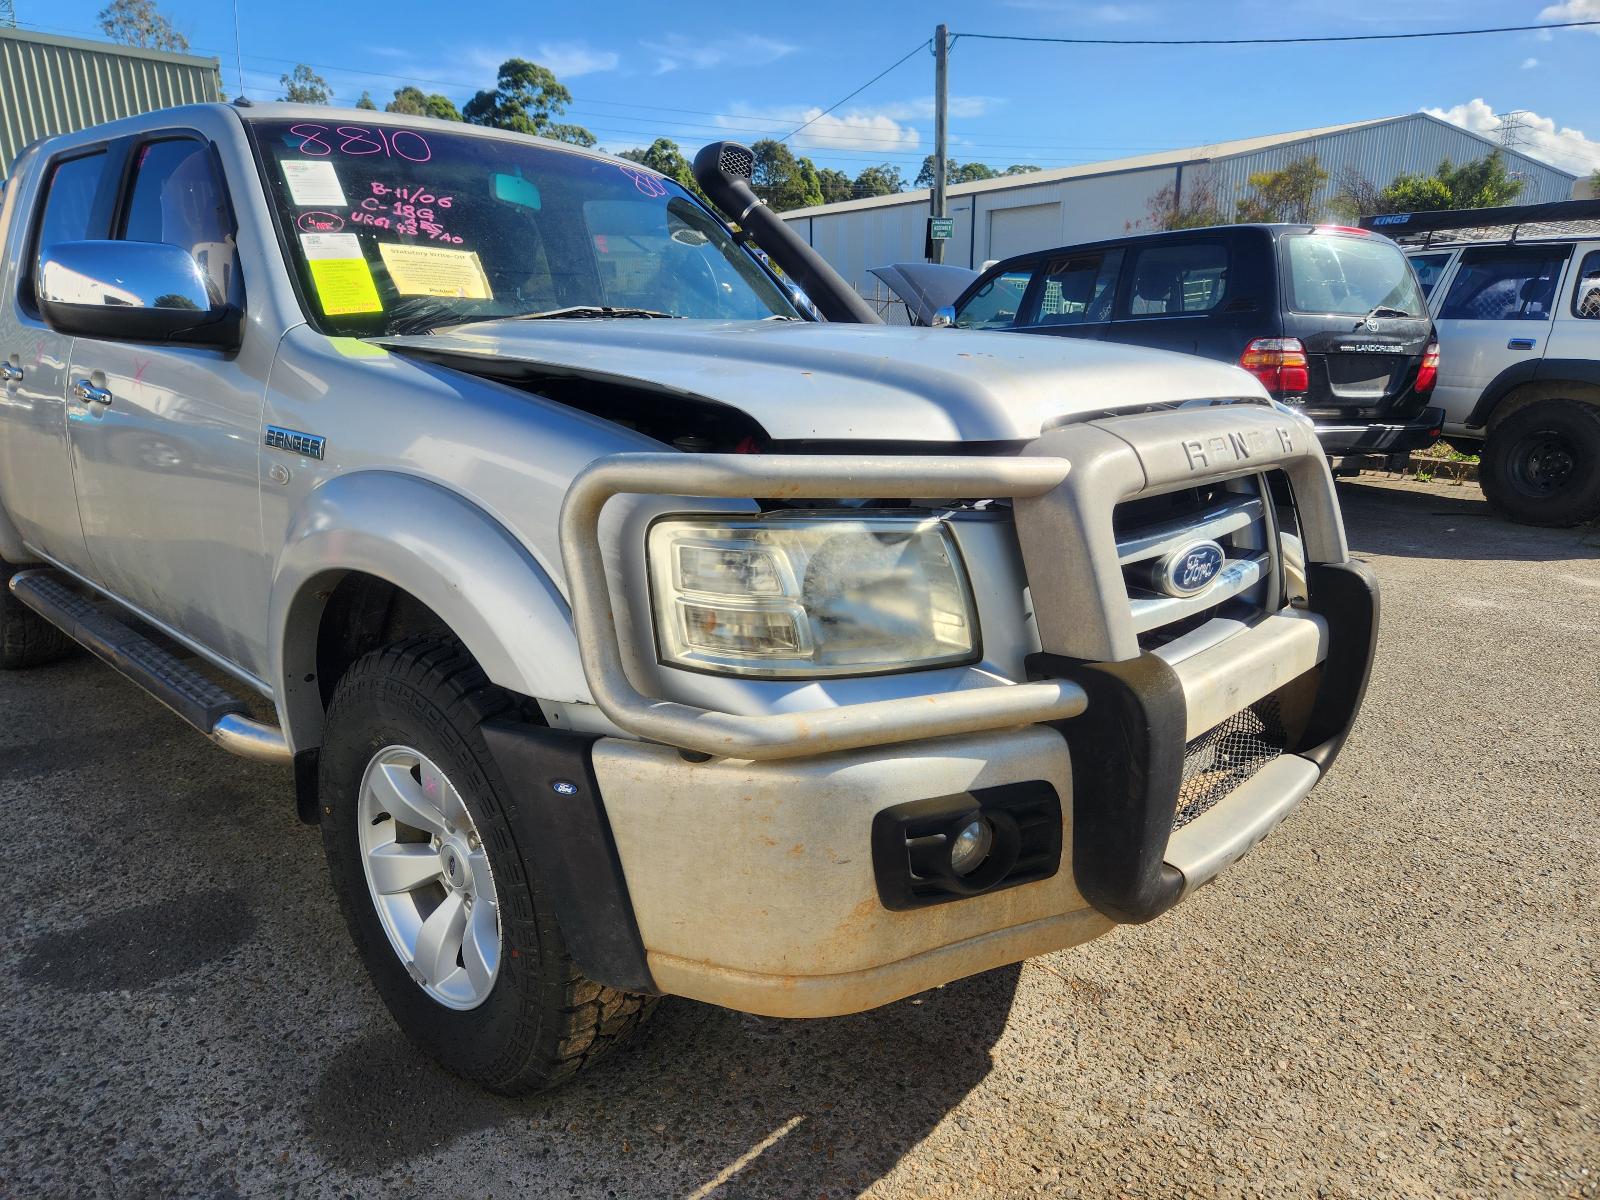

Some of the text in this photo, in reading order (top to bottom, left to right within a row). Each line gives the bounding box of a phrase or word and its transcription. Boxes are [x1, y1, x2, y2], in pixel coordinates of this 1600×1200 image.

[290, 124, 431, 161] 8810
[1373, 214, 1411, 225] KINGS
[1356, 344, 1403, 353] LANDCRUISER
[266, 429, 323, 458] RANGER
[1183, 551, 1216, 586] Ford
